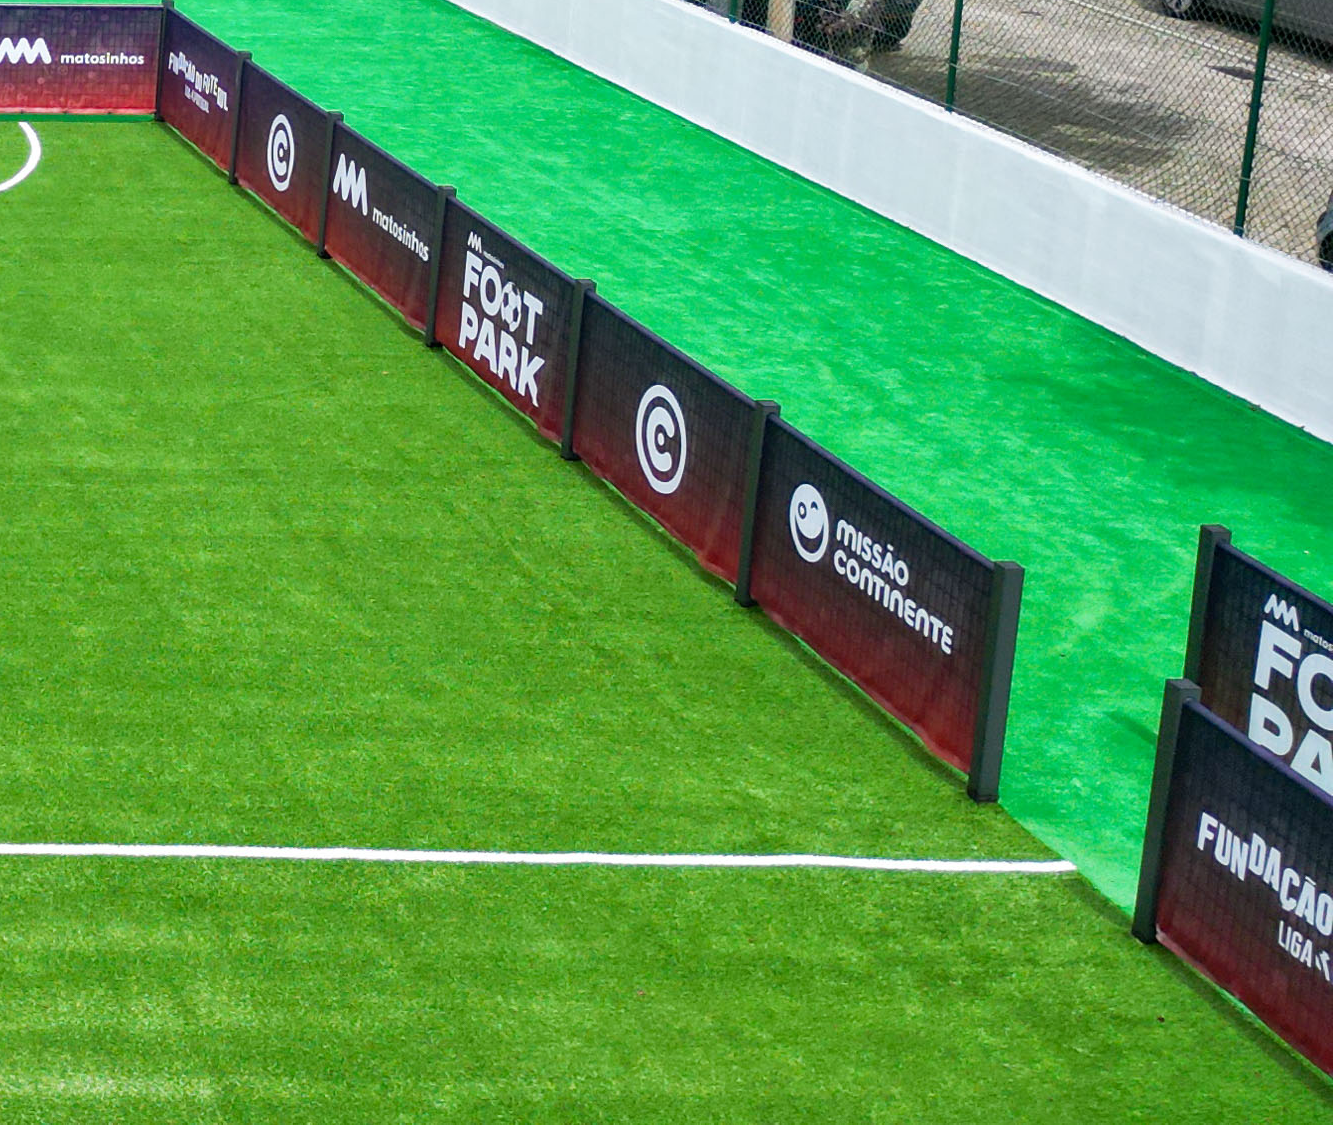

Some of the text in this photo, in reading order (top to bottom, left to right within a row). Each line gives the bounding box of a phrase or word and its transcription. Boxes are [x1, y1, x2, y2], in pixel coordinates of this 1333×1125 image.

[60, 52, 145, 65] matosinhos
[372, 206, 429, 261] matosinhos
[458, 301, 545, 407] PARK
[836, 519, 909, 586] MISSÃO
[833, 549, 954, 655] CONTINENTE
[1278, 920, 1313, 969] LIGA
